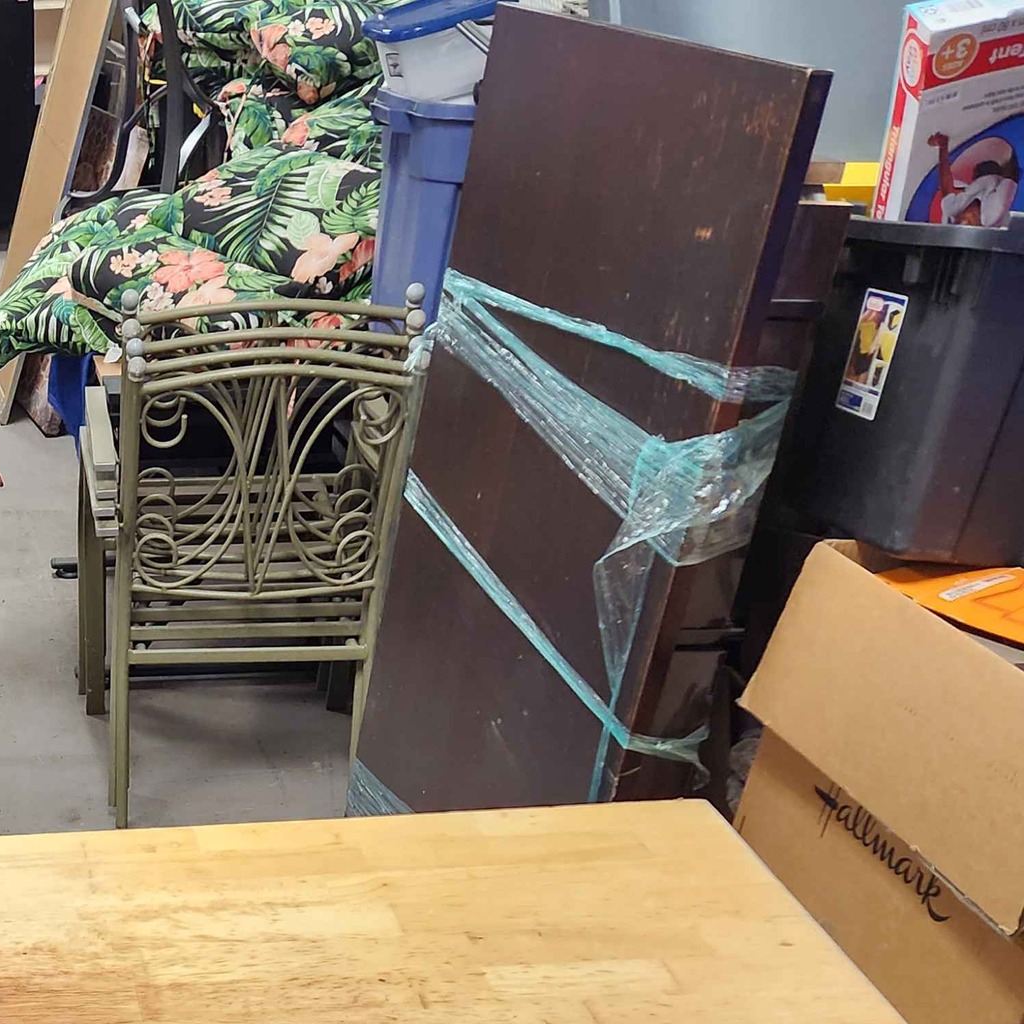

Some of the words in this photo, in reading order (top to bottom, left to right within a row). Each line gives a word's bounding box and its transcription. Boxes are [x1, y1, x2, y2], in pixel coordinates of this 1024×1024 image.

[941, 38, 972, 60] 3+
[880, 125, 900, 202] Triangular
[814, 780, 951, 922] Hallmark
